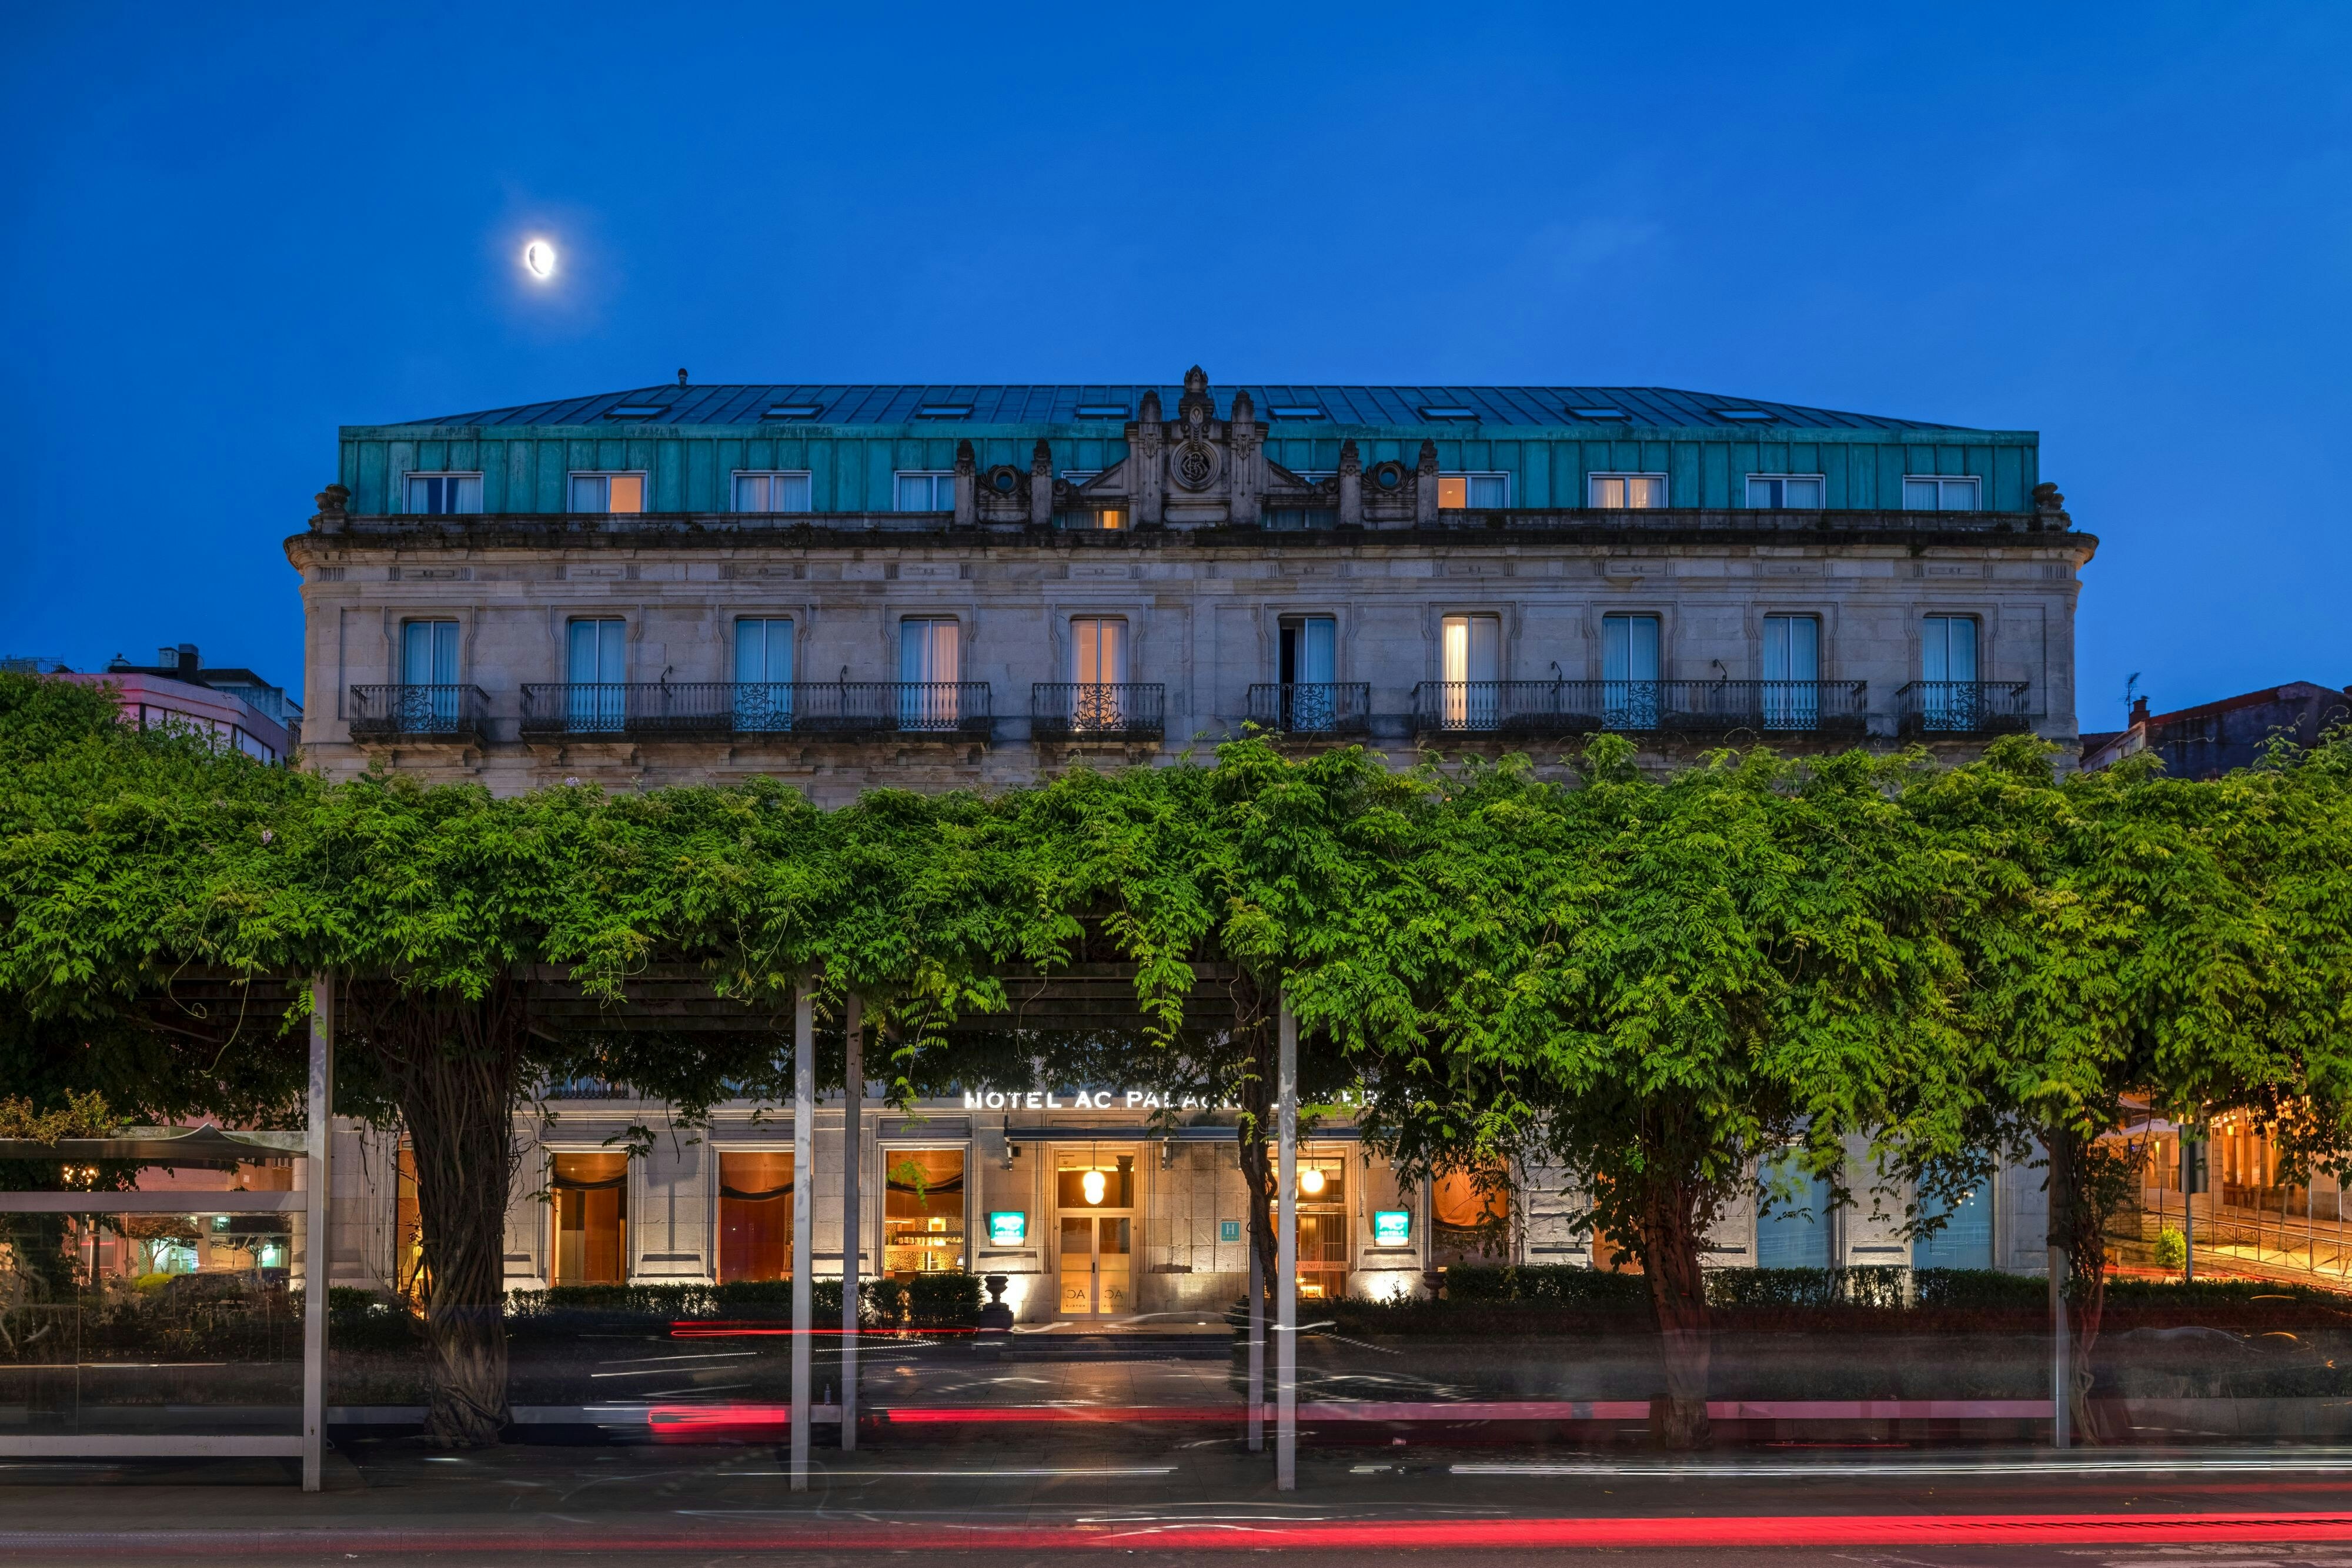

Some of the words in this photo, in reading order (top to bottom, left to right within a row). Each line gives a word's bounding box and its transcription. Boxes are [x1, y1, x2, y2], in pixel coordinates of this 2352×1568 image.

[964, 1091, 1062, 1109] HOTEL
[1074, 1091, 1112, 1108] AC
[1127, 1091, 1245, 1109] PALAC
[1226, 1224, 1234, 1235] H
